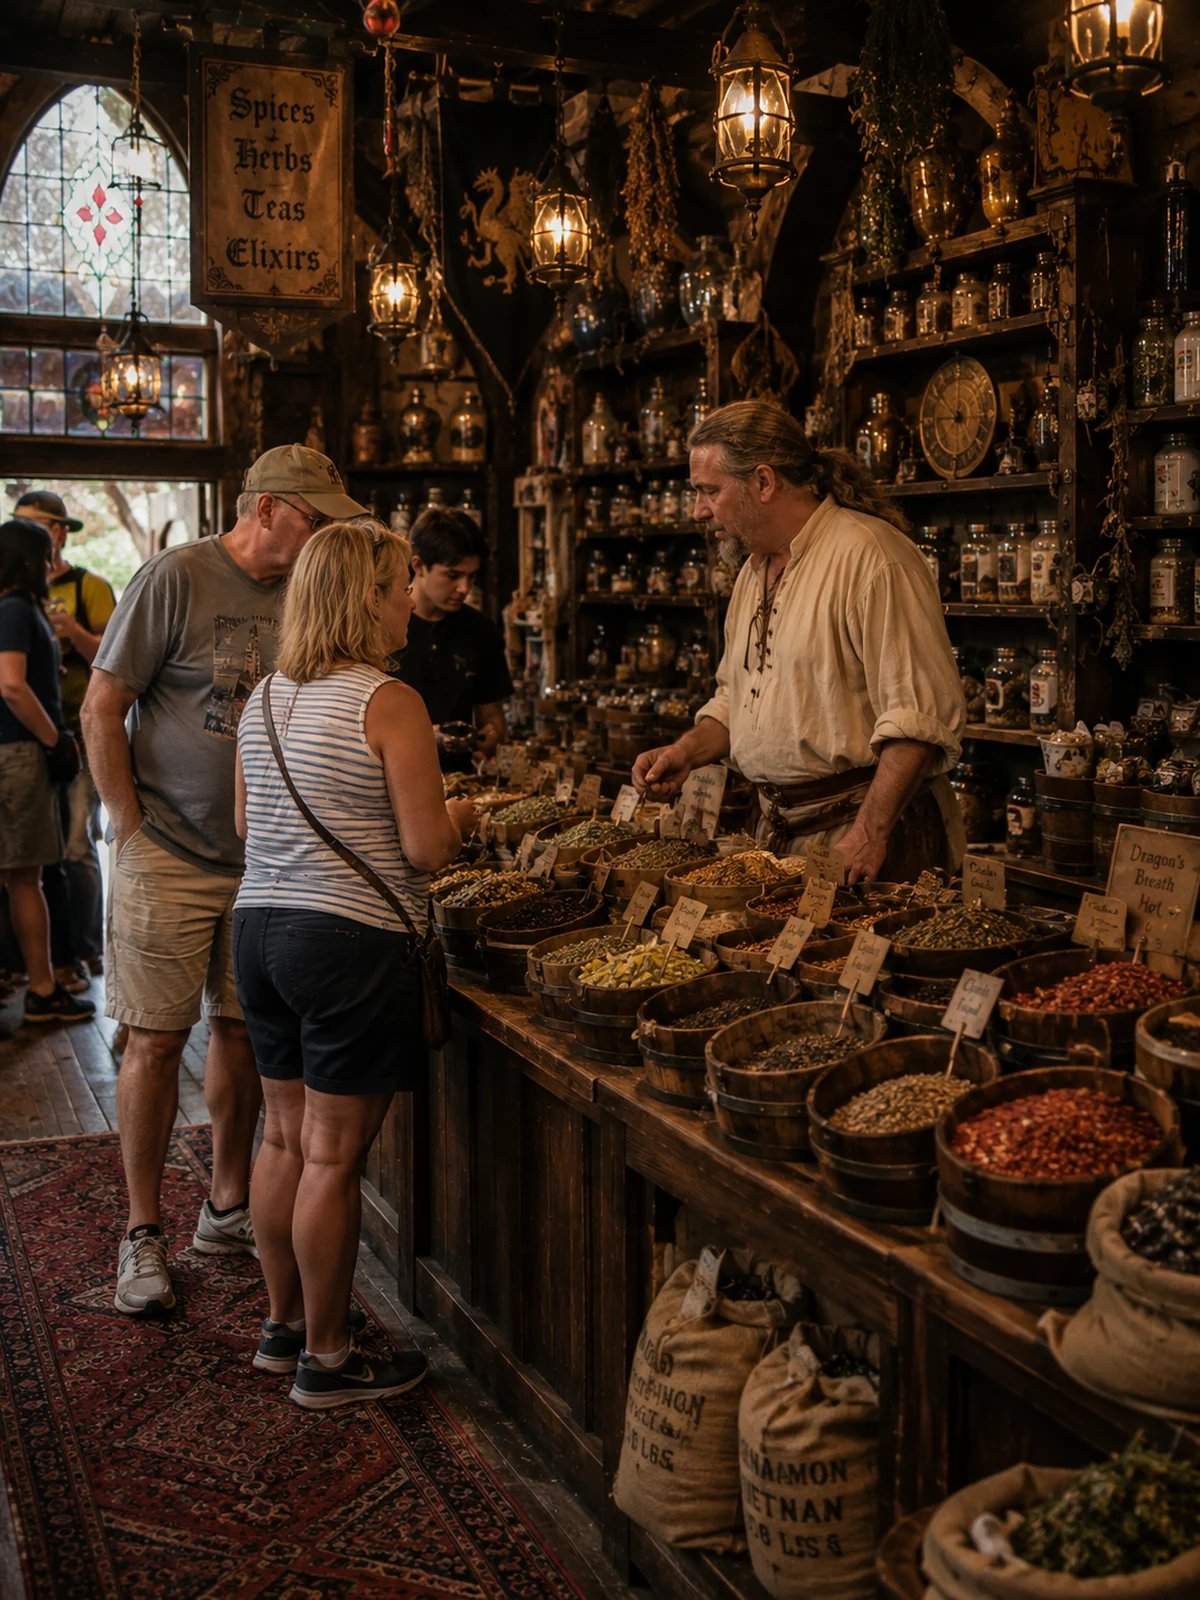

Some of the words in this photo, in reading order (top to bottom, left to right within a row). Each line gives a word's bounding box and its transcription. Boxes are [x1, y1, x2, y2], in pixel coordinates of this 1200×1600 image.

[229, 86, 315, 128] Spices
[233, 137, 312, 175] Herbs
[242, 187, 306, 222] Teas
[225, 237, 320, 273] Elixirs
[1130, 843, 1185, 870] Dragon's
[1134, 868, 1175, 893] Breath
